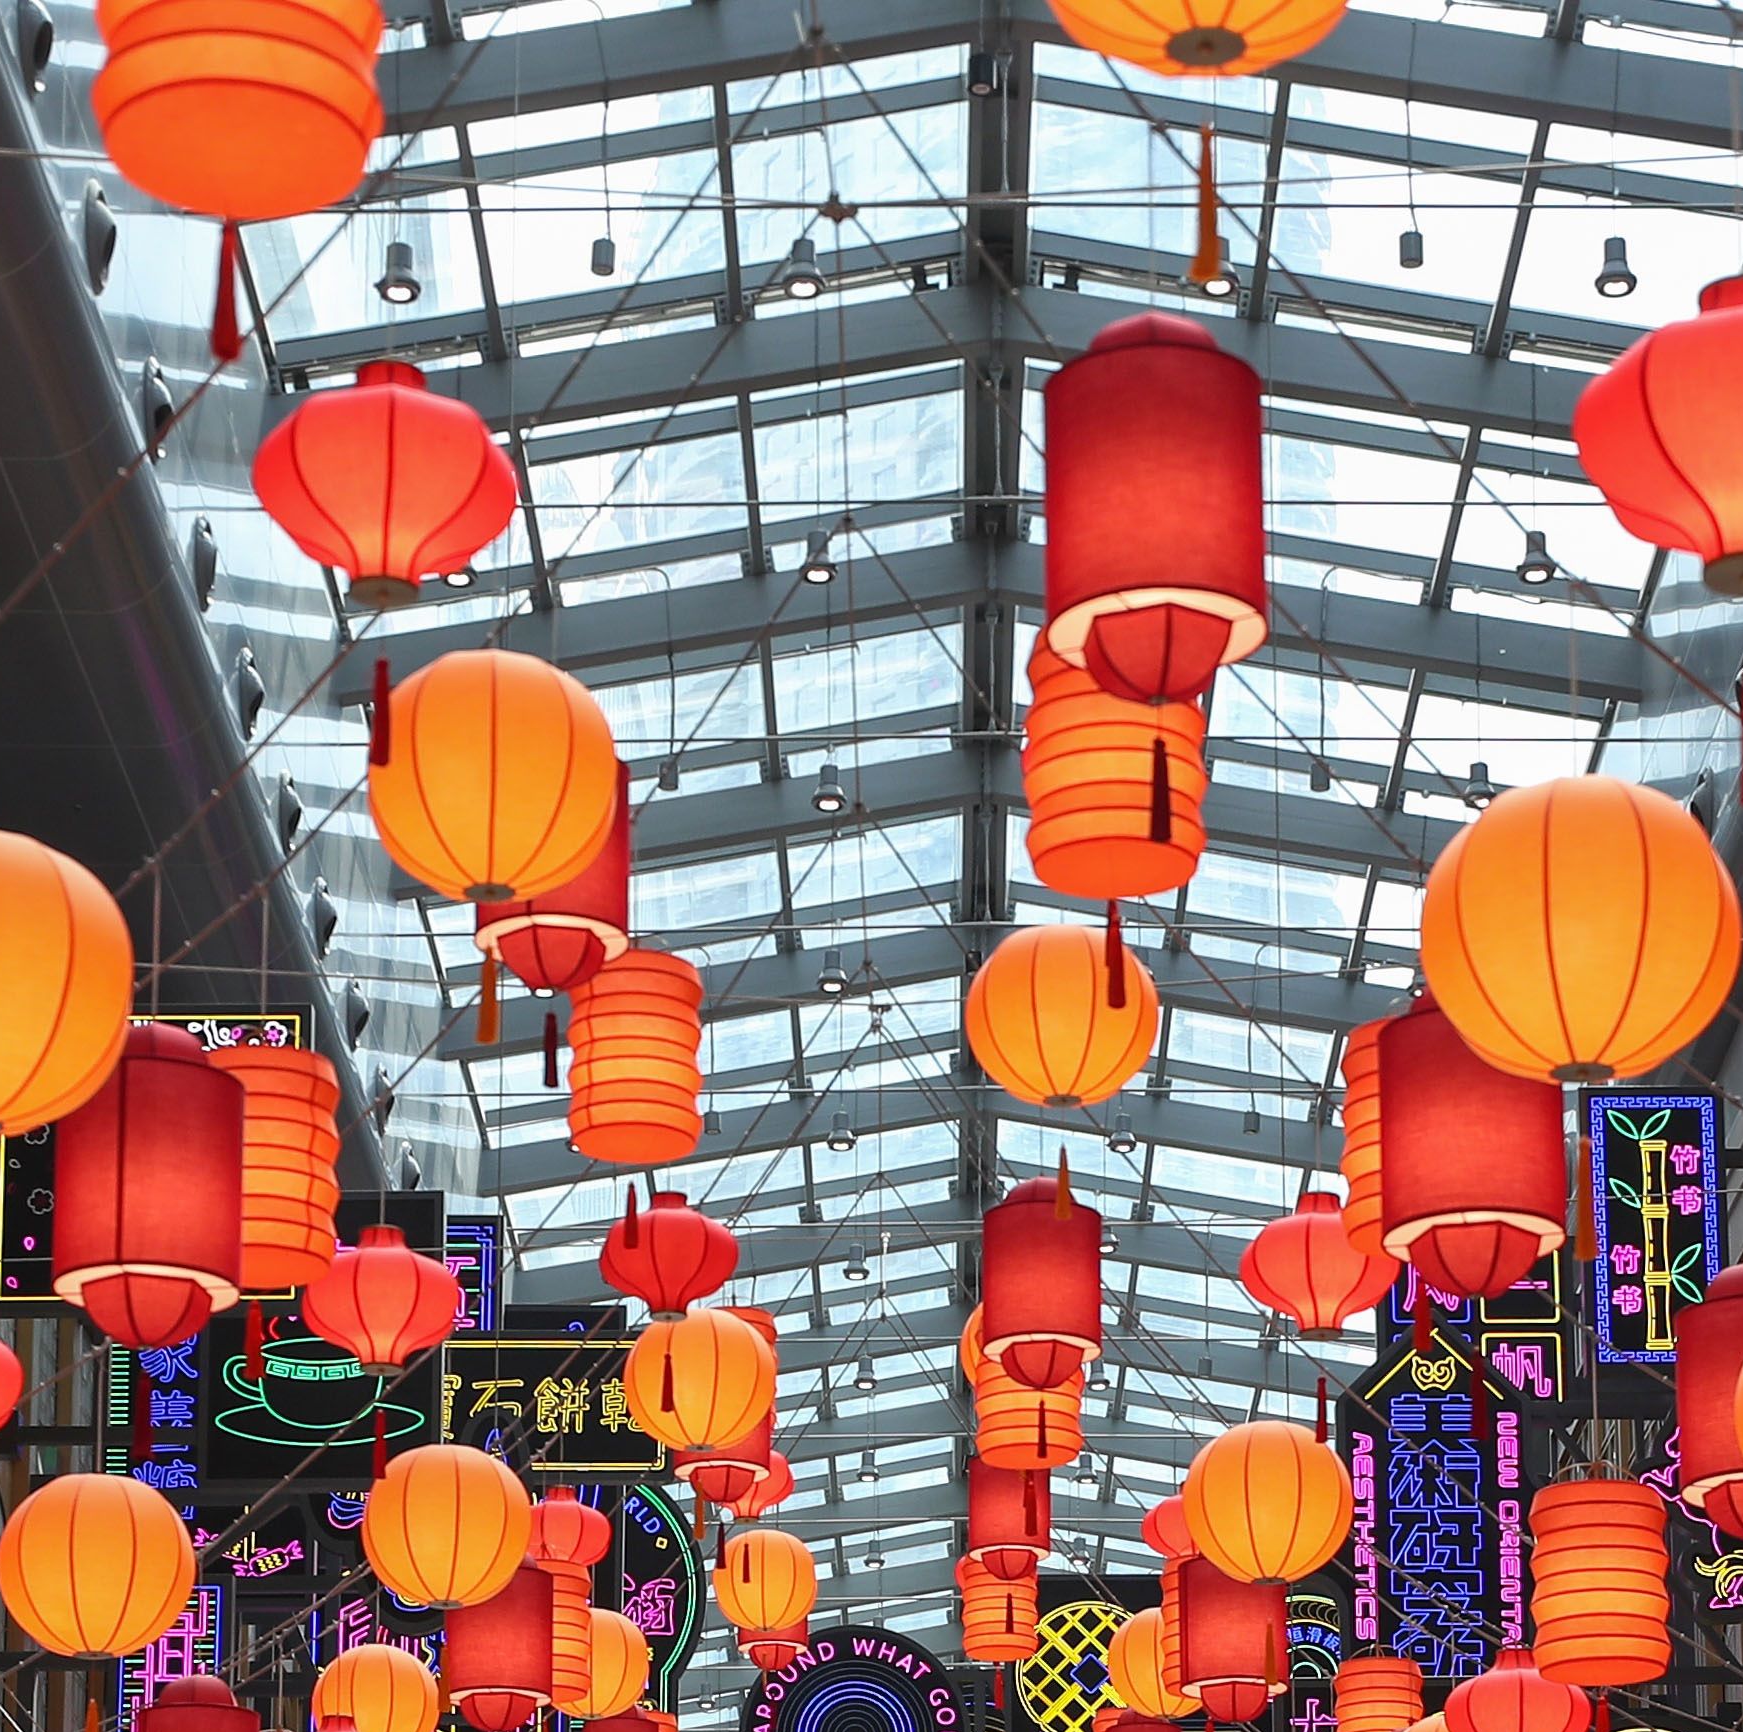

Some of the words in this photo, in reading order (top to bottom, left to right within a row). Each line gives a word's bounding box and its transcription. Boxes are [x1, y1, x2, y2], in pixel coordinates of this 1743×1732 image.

[1496, 1411, 1519, 1490] NEW
[1351, 1431, 1377, 1641] AESTHETICS
[1498, 1499, 1524, 1650] ORIENTA
[852, 1637, 932, 1681] WHAT
